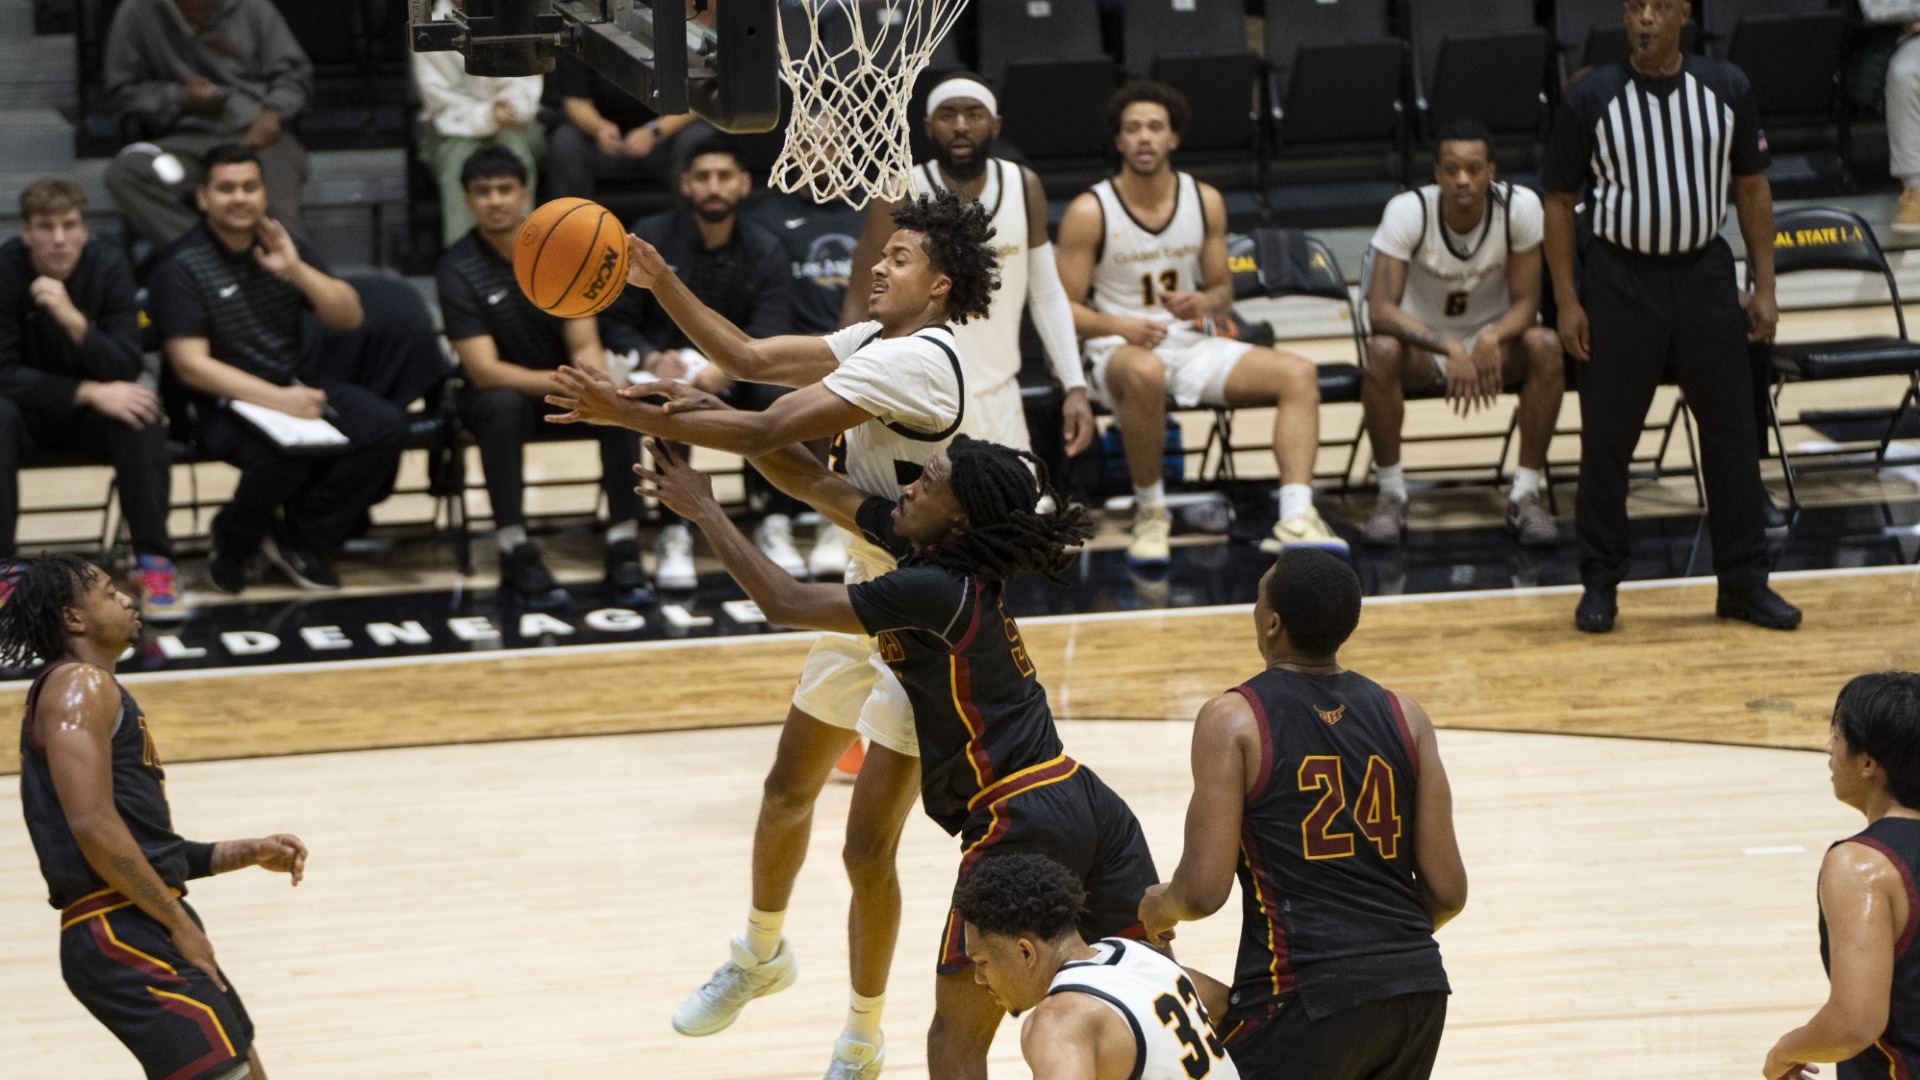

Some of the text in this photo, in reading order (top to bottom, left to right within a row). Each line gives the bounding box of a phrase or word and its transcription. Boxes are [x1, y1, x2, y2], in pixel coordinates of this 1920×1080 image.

[1774, 231, 1795, 248] AL
[1796, 227, 1838, 246] STATE
[582, 246, 619, 300] NCAA
[1227, 256, 1257, 272] CAL
[1444, 290, 1469, 317] 6
[1297, 755, 1402, 860] 24
[1152, 973, 1225, 1080] 33
